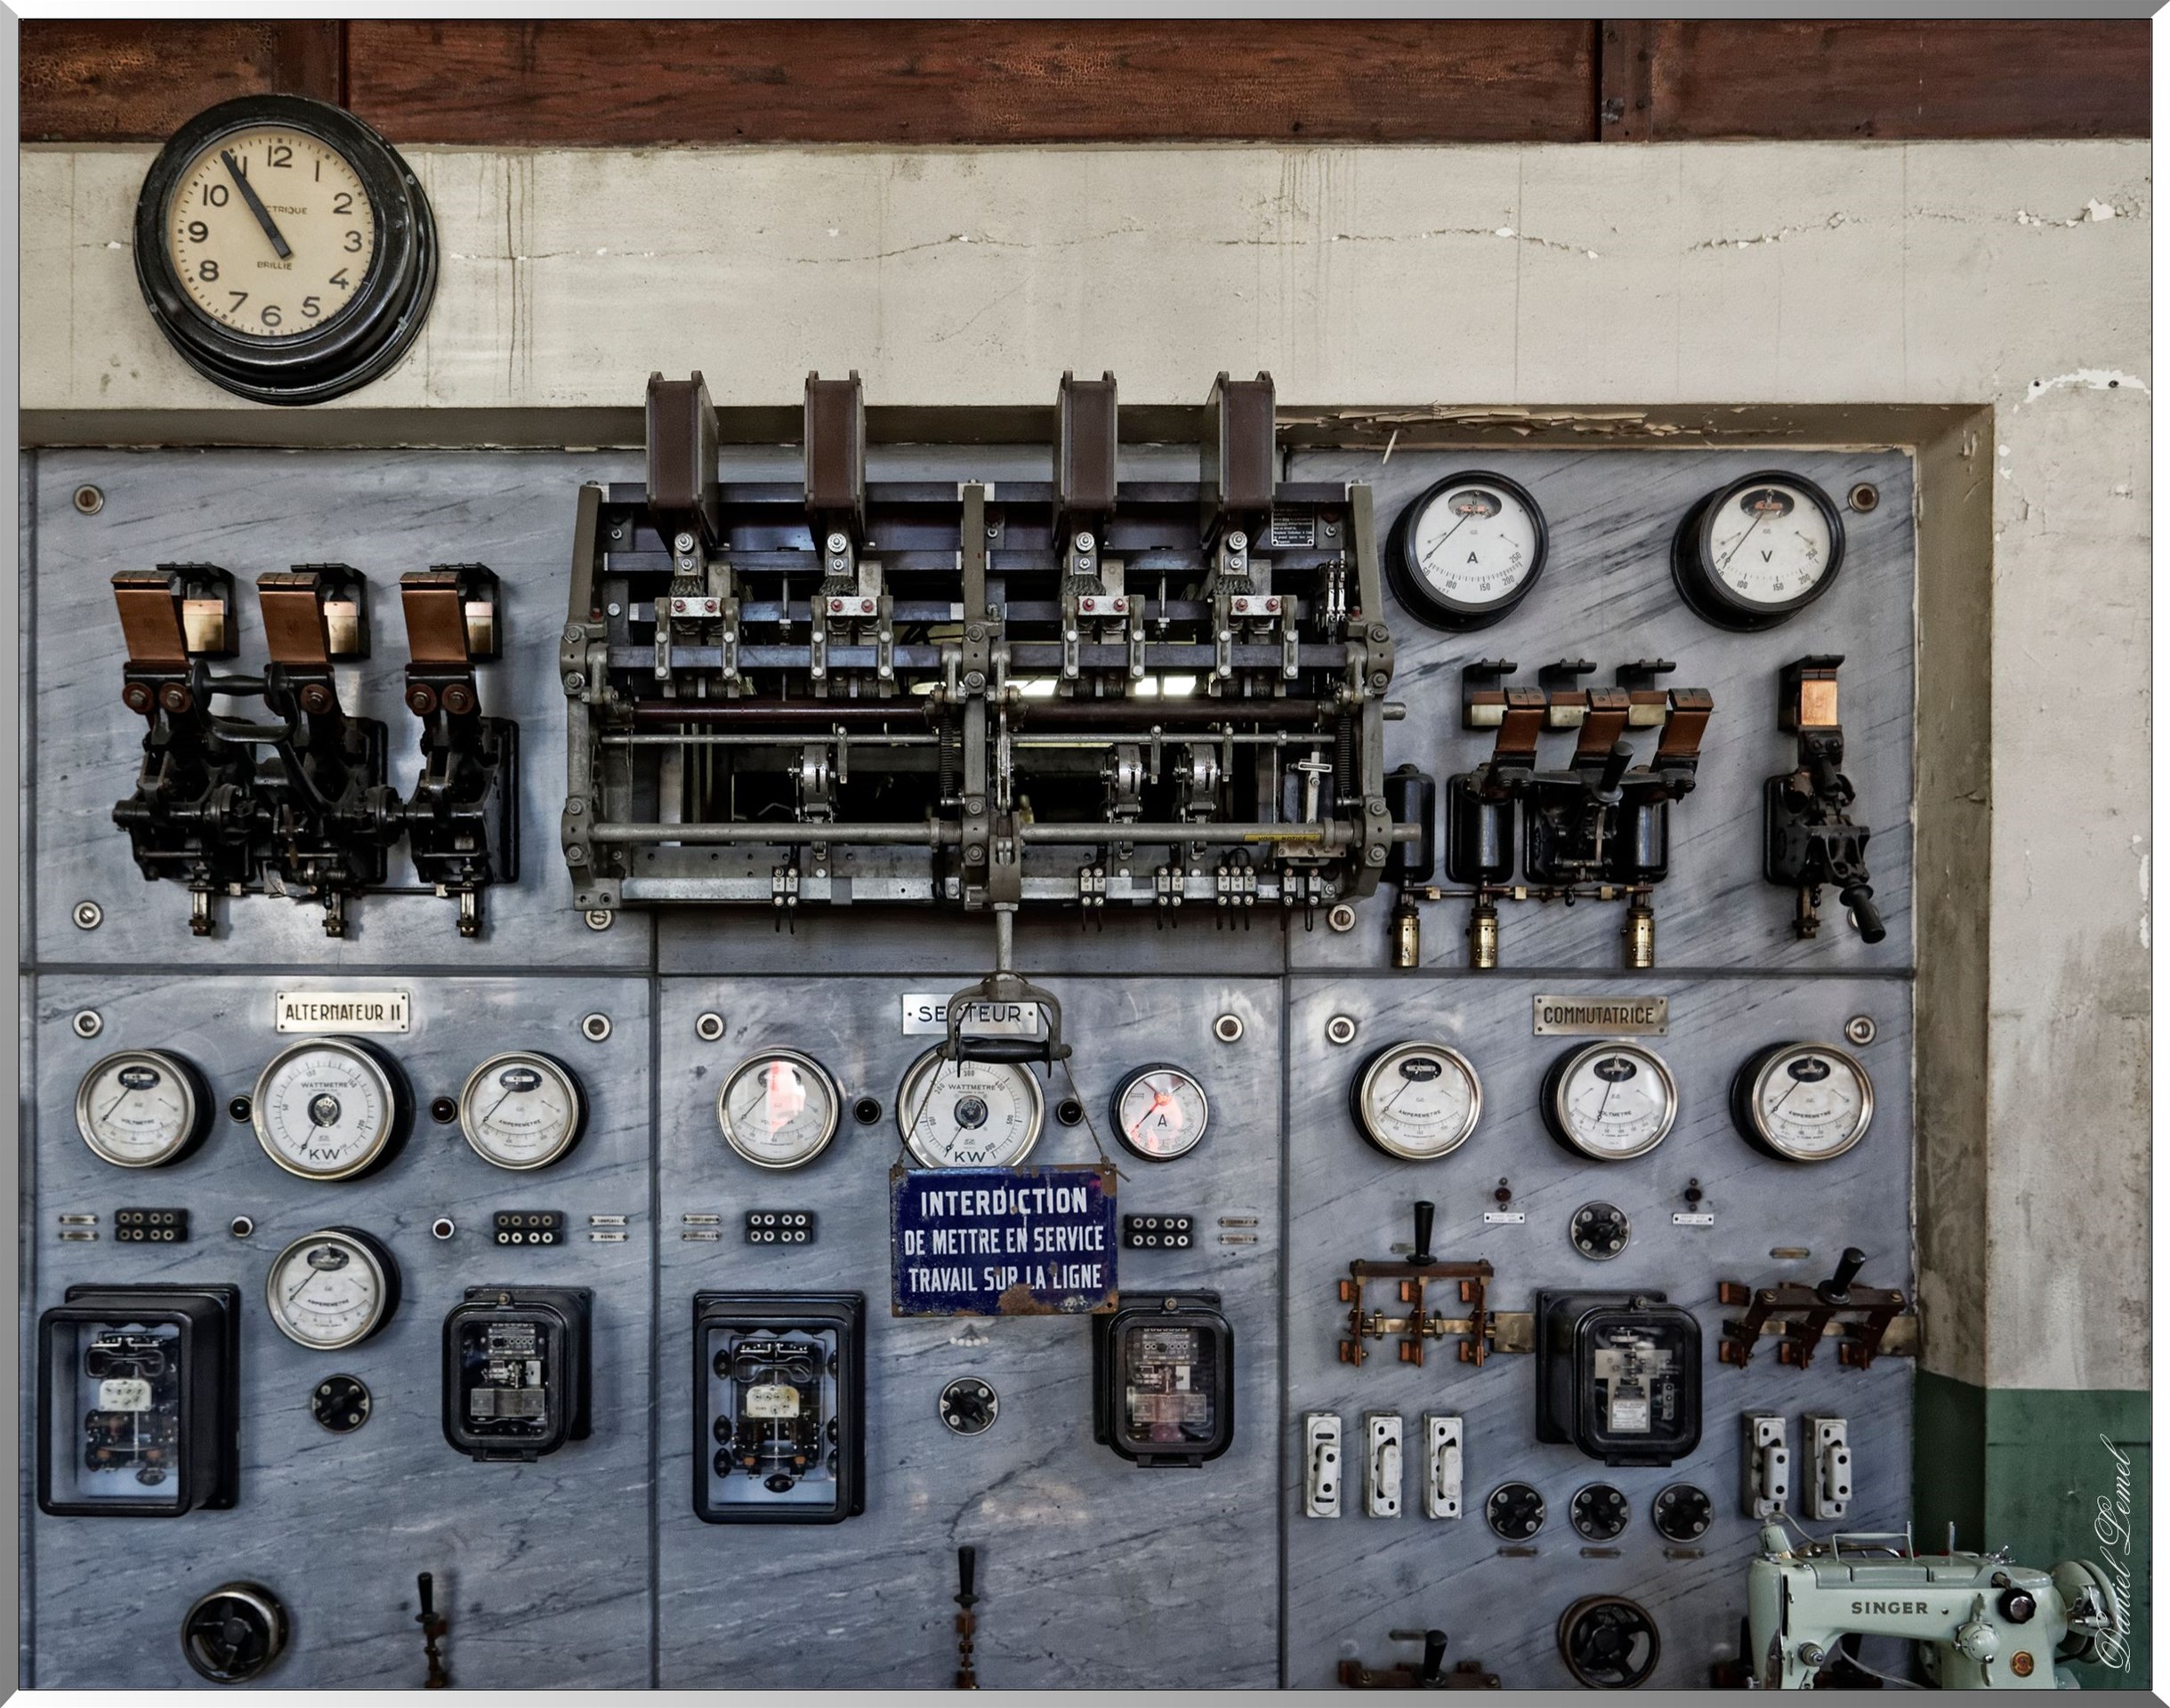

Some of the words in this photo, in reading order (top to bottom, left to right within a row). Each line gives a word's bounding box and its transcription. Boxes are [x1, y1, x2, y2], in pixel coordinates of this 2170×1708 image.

[268, 145, 293, 168] 12
[315, 160, 320, 182] 1
[203, 184, 229, 206] 10
[333, 192, 353, 214] 2
[264, 205, 308, 214] CTRIQUE
[188, 221, 208, 243] 9
[343, 230, 362, 253] 3
[199, 260, 219, 282] 8
[329, 268, 349, 289] 4
[229, 291, 248, 313] 7
[301, 296, 320, 318] 5
[261, 305, 281, 326] 6
[1466, 552, 1478, 564] A
[1509, 552, 1522, 563] 250
[1761, 550, 1773, 563] V
[1445, 580, 1457, 590] 100
[1480, 584, 1491, 592] 150
[1502, 576, 1515, 586] 200
[1737, 580, 1748, 590] 100
[1773, 583, 1785, 591] 150
[1798, 576, 1811, 585] 200
[286, 1004, 383, 1020] ALTERNATEUR
[1544, 1006, 1655, 1024] COMMUTATRICE
[1158, 1114, 1167, 1127] A
[1399, 1109, 1441, 1118] AMPEREMETRE
[309, 1149, 340, 1160] KW
[955, 1151, 986, 1163] KW
[921, 1187, 1087, 1217] INTERDICTION
[904, 1229, 925, 1256] DE
[932, 1228, 1001, 1255] METTRE
[1005, 1227, 1028, 1253] EN
[1034, 1225, 1105, 1253] SERVICE
[908, 1266, 978, 1293] TRAVAIL
[983, 1265, 1018, 1292] SUR
[1026, 1264, 1046, 1290] LA
[1053, 1263, 1102, 1289] LIGNE
[1851, 1600, 1929, 1615] SINGER
